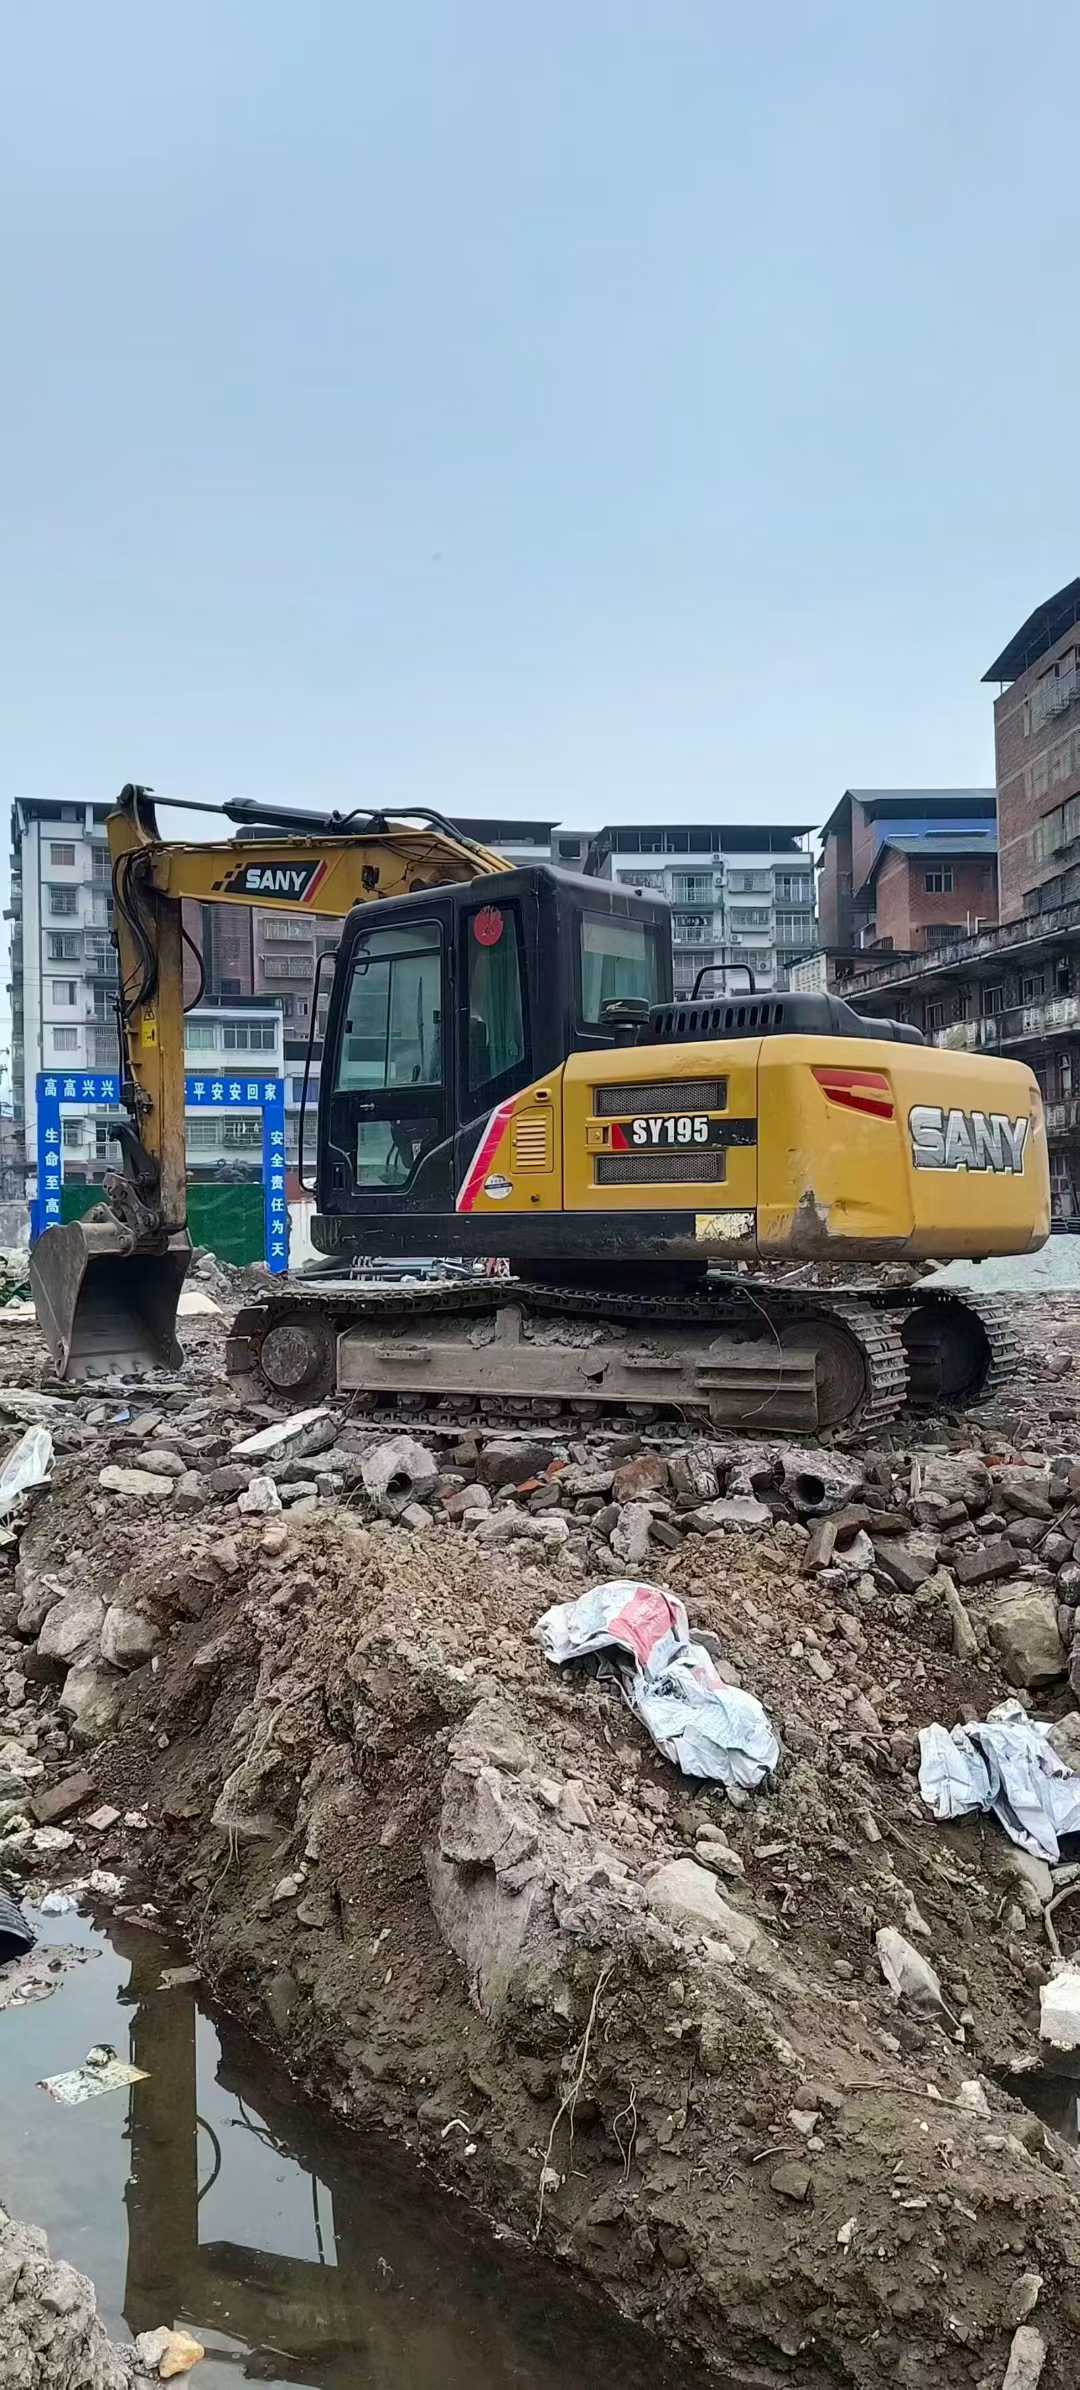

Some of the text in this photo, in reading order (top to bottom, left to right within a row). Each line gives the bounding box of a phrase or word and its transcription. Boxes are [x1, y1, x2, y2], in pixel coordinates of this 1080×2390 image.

[246, 869, 307, 891] SANY
[44, 1078, 277, 1101] 高高兴兴 平安安回家
[632, 1117, 708, 1144] SY195
[909, 1105, 1029, 1176] SANY
[270, 1130, 284, 1257] 安全责任为天
